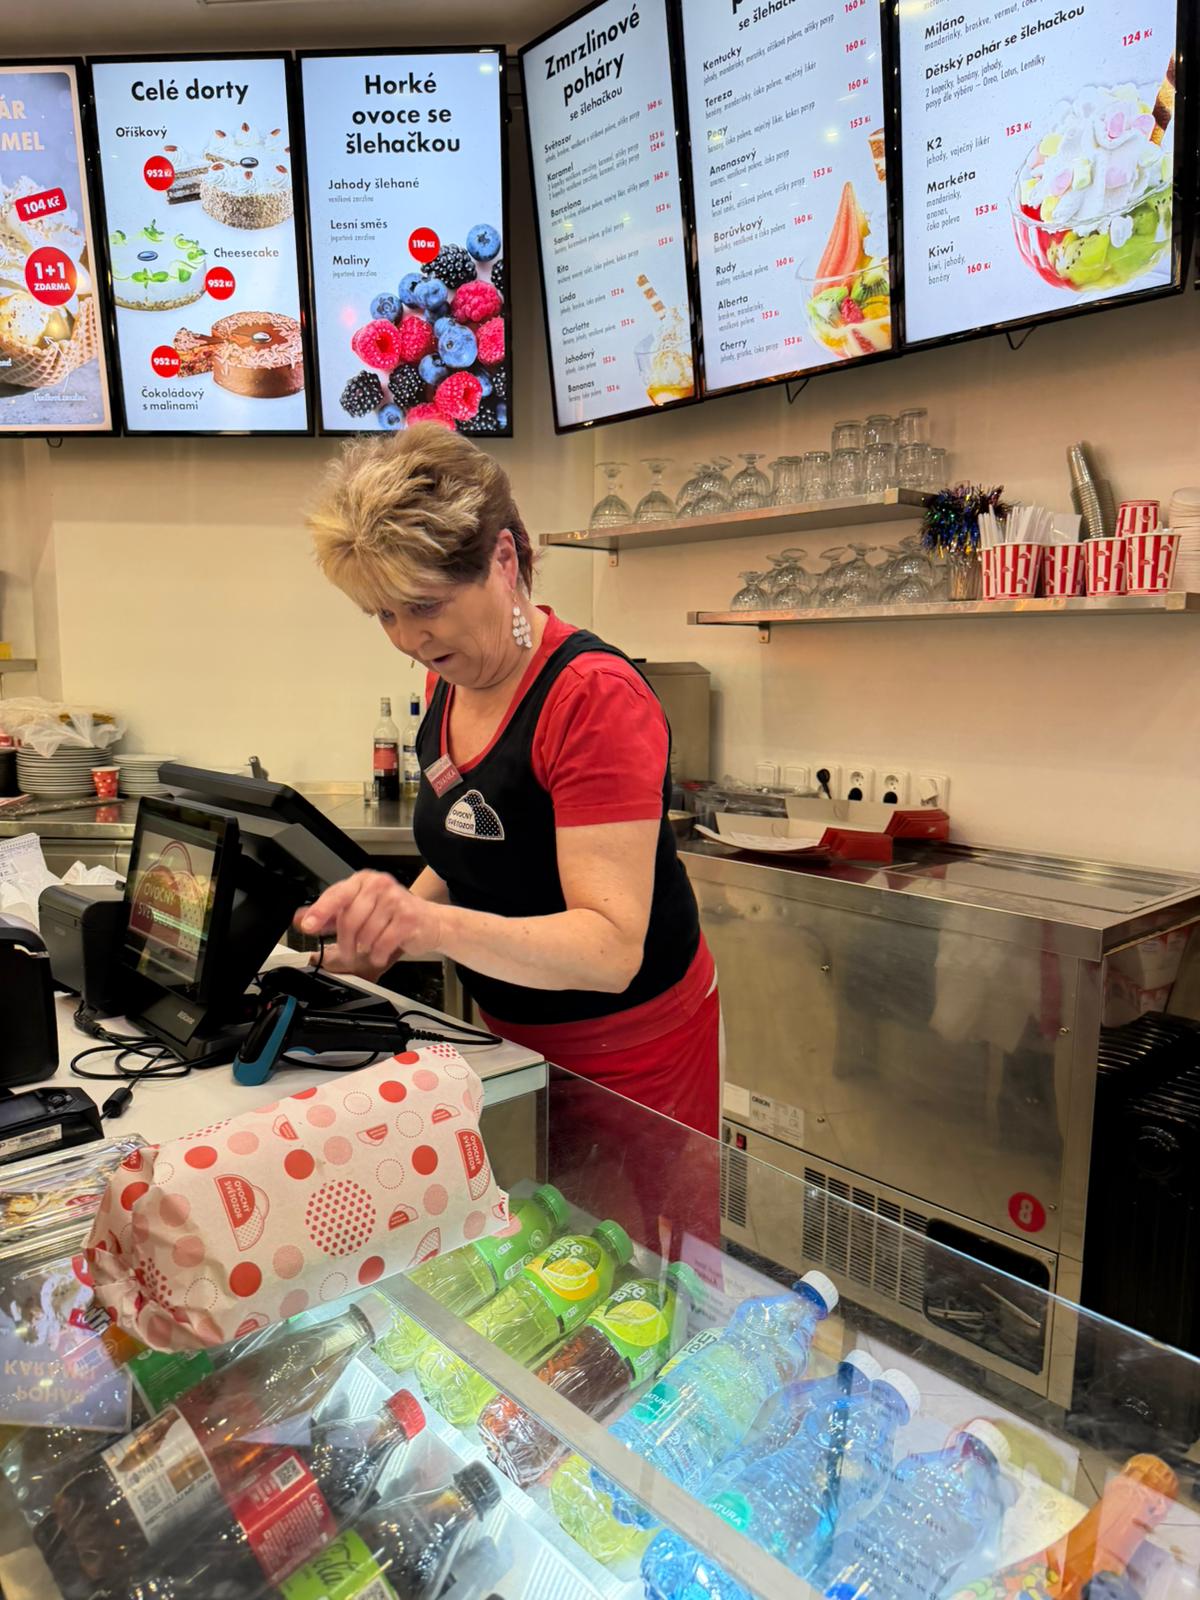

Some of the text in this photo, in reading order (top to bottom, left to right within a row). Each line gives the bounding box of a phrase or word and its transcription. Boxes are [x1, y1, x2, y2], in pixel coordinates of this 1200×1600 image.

[844, 1, 858, 13] 160
[739, 18, 750, 31] se
[925, 14, 964, 39] Miláno
[545, 3, 640, 80] Zmrzlinové
[925, 5, 1085, 80] Dětský pohár se šlehačkou
[1122, 30, 1141, 47] 124
[845, 40, 859, 53] 160
[702, 47, 742, 71] Kentucky
[364, 71, 438, 95] Horké
[563, 53, 625, 107] poháry
[848, 80, 861, 92] 160
[131, 77, 249, 105] Celé dorty
[705, 88, 733, 108] Tereza
[570, 86, 624, 121] se šlehačkou
[352, 108, 453, 125] ovoce se
[850, 117, 863, 128] 153
[116, 126, 168, 139] Oříškový
[1006, 123, 1021, 136] 153
[1, 131, 45, 152] MEL
[346, 131, 461, 154] šlehačkou
[544, 133, 572, 154] Světozor
[927, 137, 942, 152] K2
[709, 147, 757, 176] Ananasový
[147, 169, 163, 178] 952
[547, 161, 574, 182] Karamel
[813, 168, 825, 180] 153
[328, 177, 420, 192] Jahody šlehané
[927, 170, 977, 194] Markéta
[24, 195, 60, 215] 104 Kč
[711, 191, 732, 208] Lesní
[550, 199, 582, 218] Barcelona
[975, 204, 989, 216] 153
[330, 218, 388, 230] Lesní směs
[794, 215, 806, 225] 160
[713, 215, 764, 243] Borůvkový
[411, 239, 425, 249] 110
[928, 240, 954, 259] Kiwi
[213, 247, 280, 259] Cheesecake
[332, 254, 371, 268] Maliny
[34, 261, 66, 280] 1+1
[715, 261, 737, 277] Rudy
[968, 263, 982, 275] 160
[34, 283, 71, 292] ZDARMA
[208, 279, 223, 288] 952
[718, 295, 749, 310] Alberta
[562, 321, 590, 336] Charlotte
[720, 338, 748, 352] Cherry
[153, 357, 170, 366] 952
[565, 348, 596, 365] Jahodový
[141, 387, 205, 401] Čokoládový
[143, 398, 199, 411] s malinami
